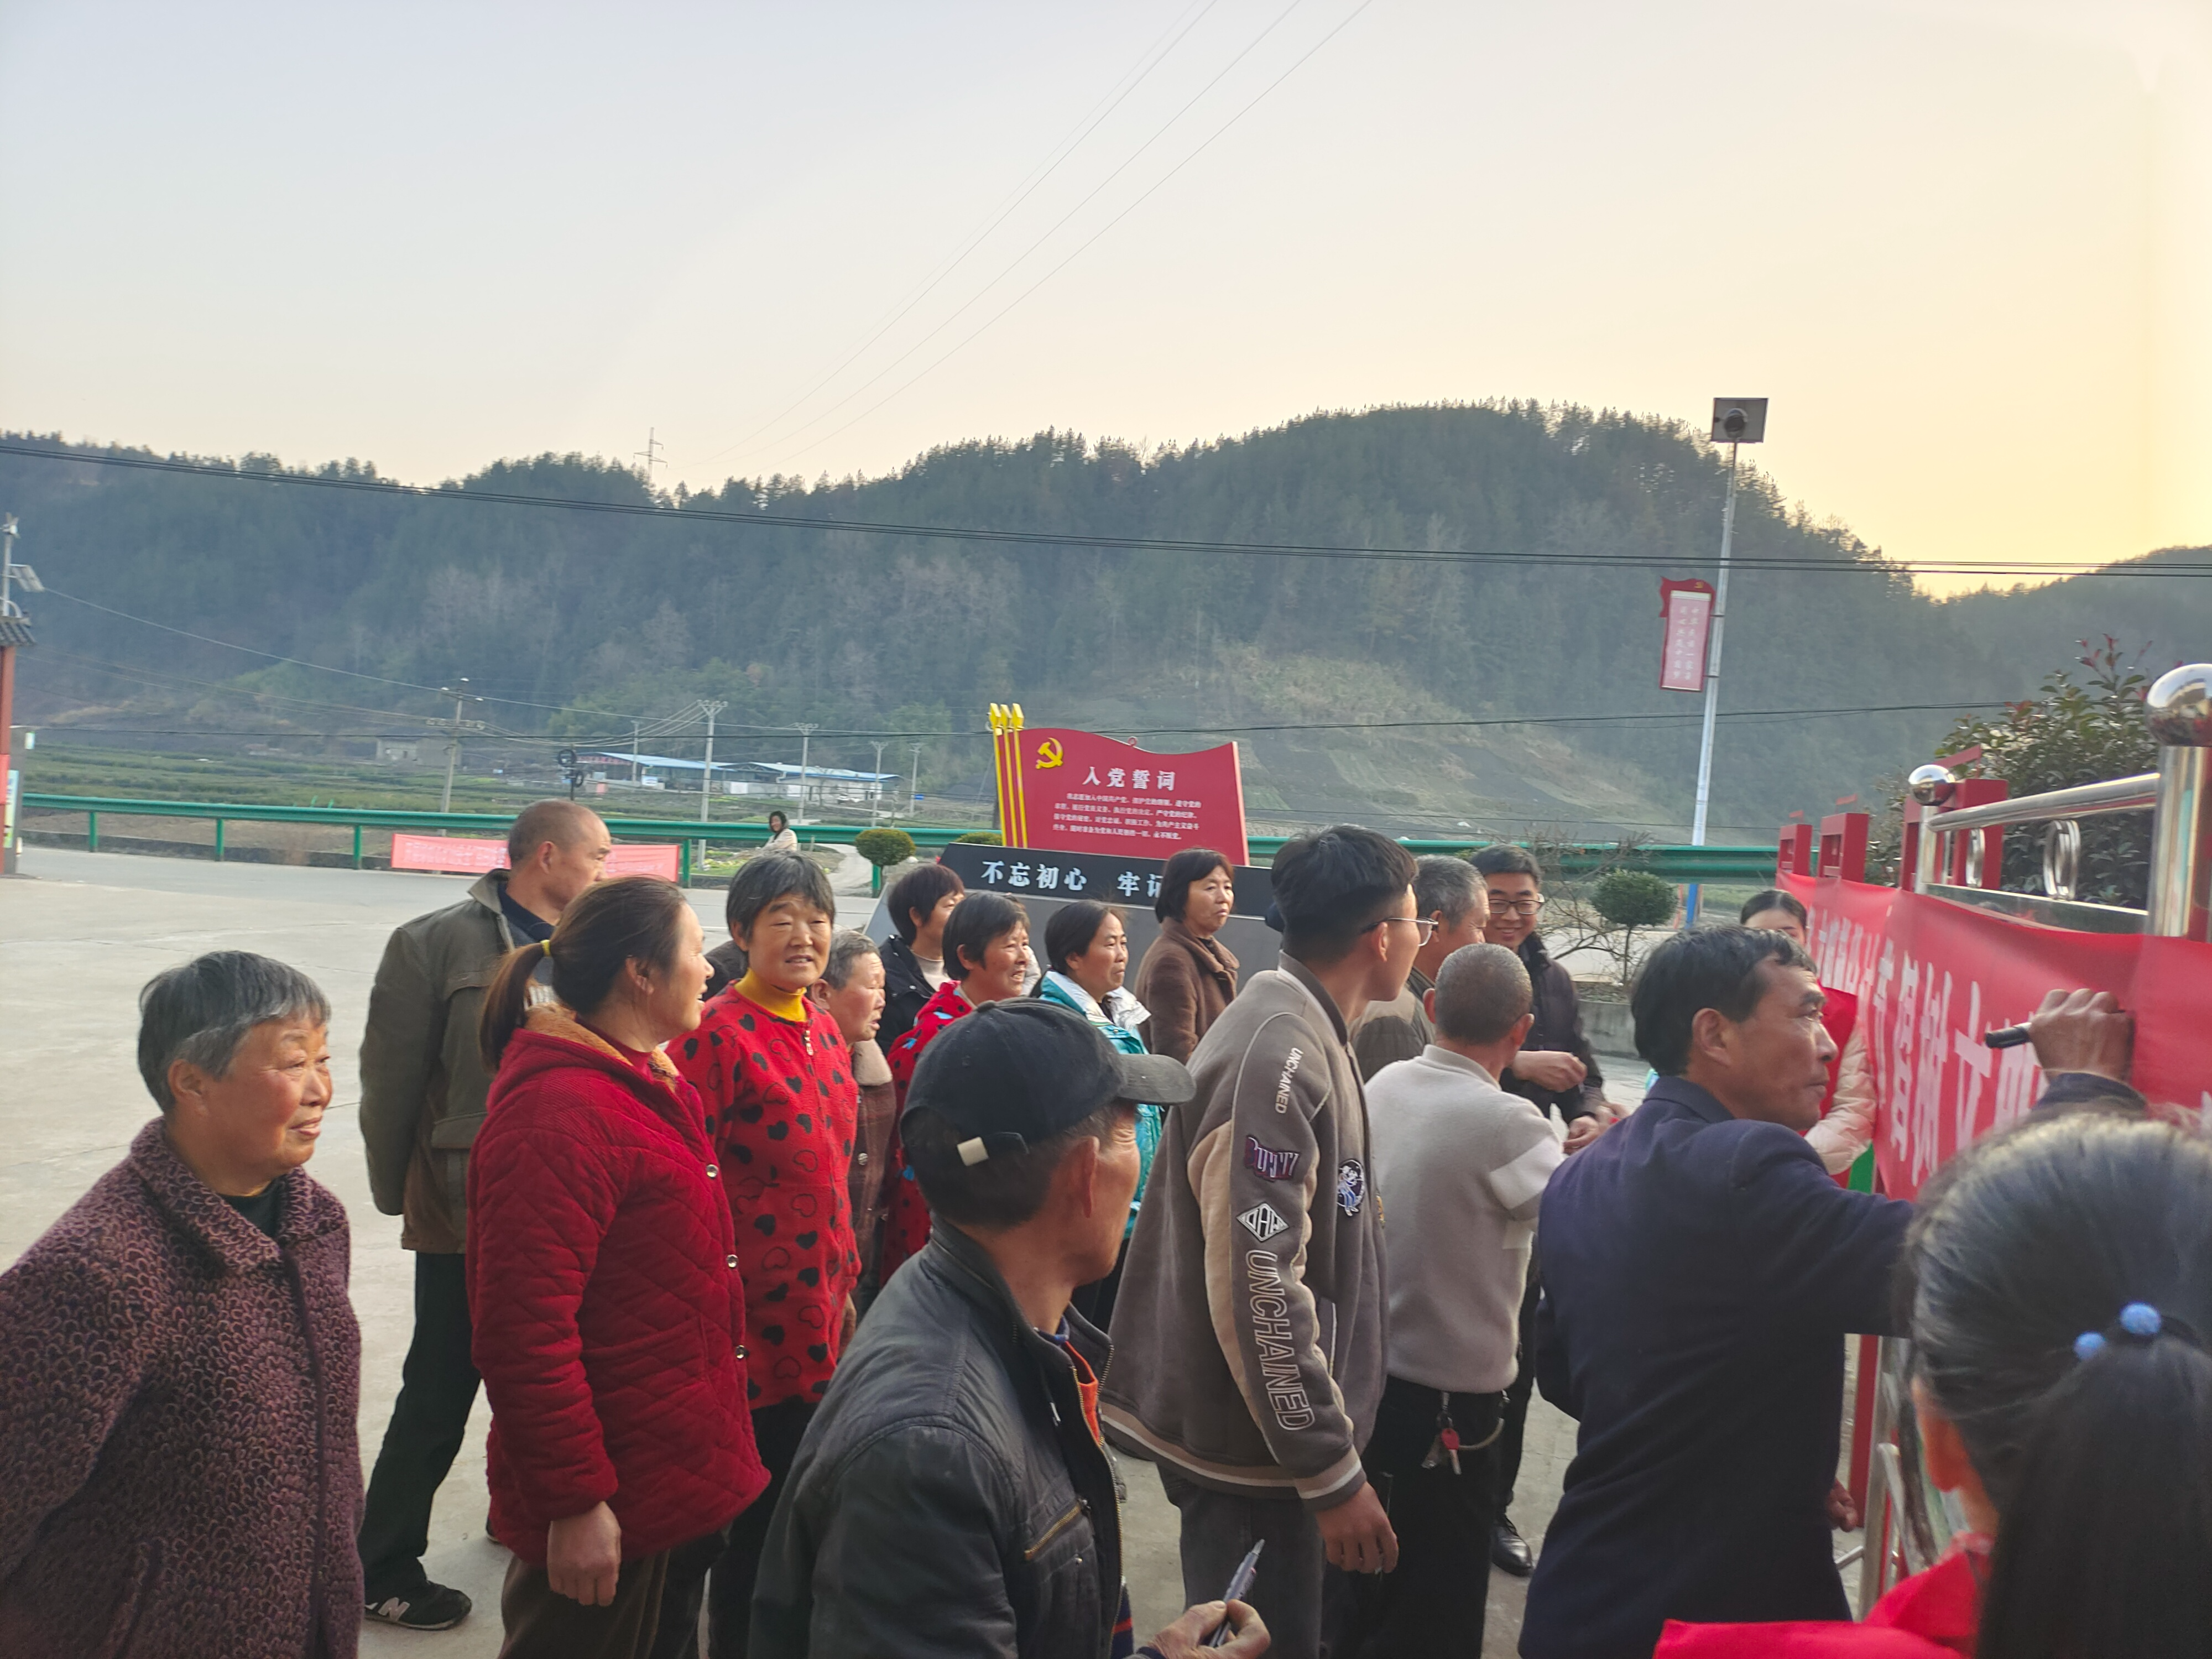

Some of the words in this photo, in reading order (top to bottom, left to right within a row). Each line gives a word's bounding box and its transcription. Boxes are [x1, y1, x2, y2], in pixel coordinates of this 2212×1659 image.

[1082, 766, 1175, 791] 入党誓词
[980, 860, 1088, 891] 不忘初心
[1275, 1047, 1304, 1115] UNCHAINED
[1245, 1249, 1315, 1431] UNCHAINED
